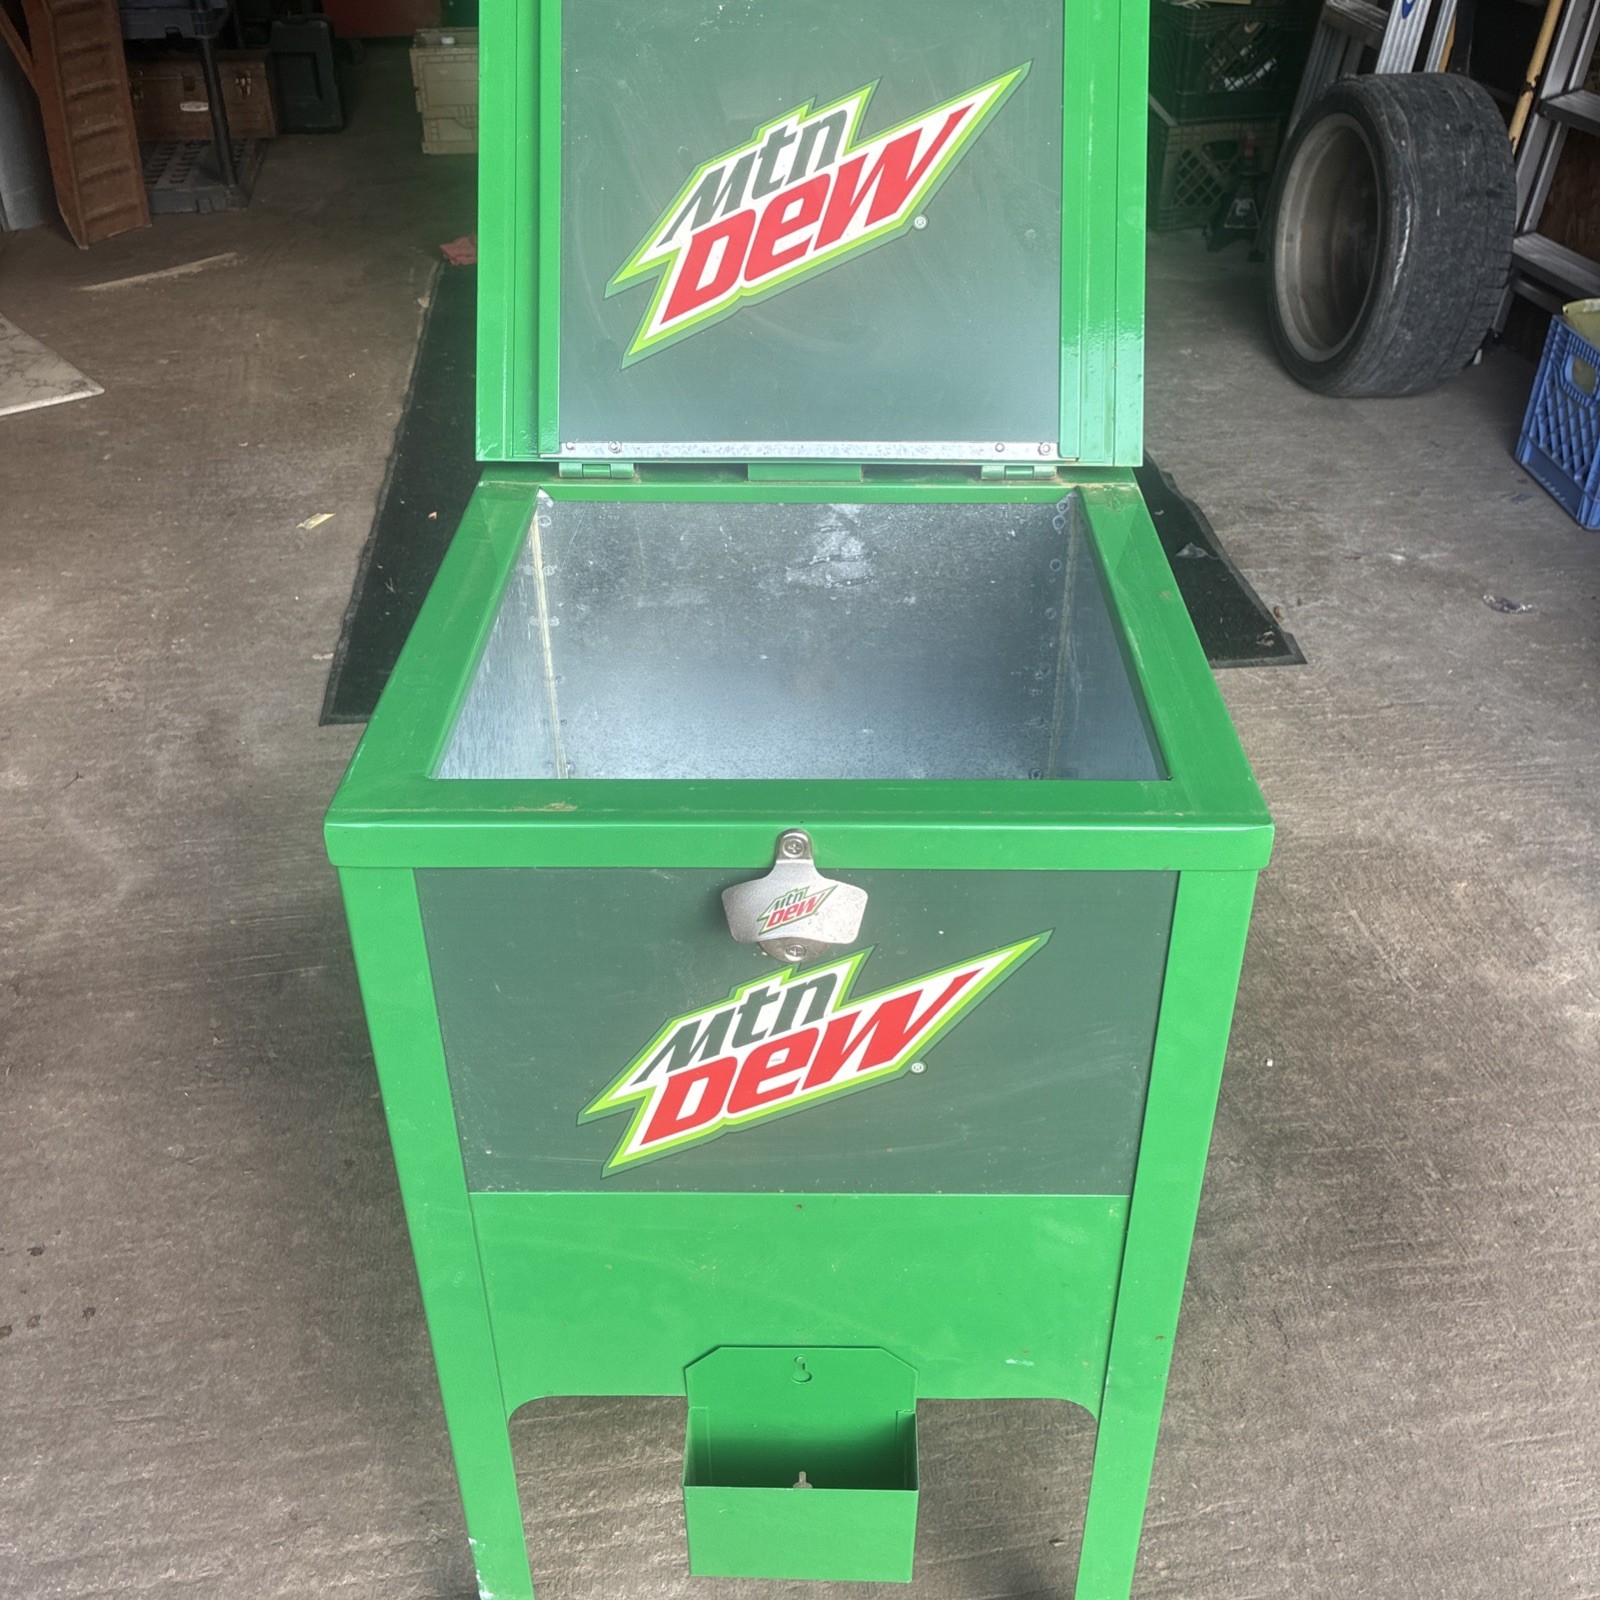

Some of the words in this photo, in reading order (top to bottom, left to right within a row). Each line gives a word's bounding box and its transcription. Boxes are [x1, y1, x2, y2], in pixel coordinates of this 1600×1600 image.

[656, 109, 848, 248] Mtn
[767, 891, 804, 914] Mtn
[629, 973, 839, 1086] Mtn
